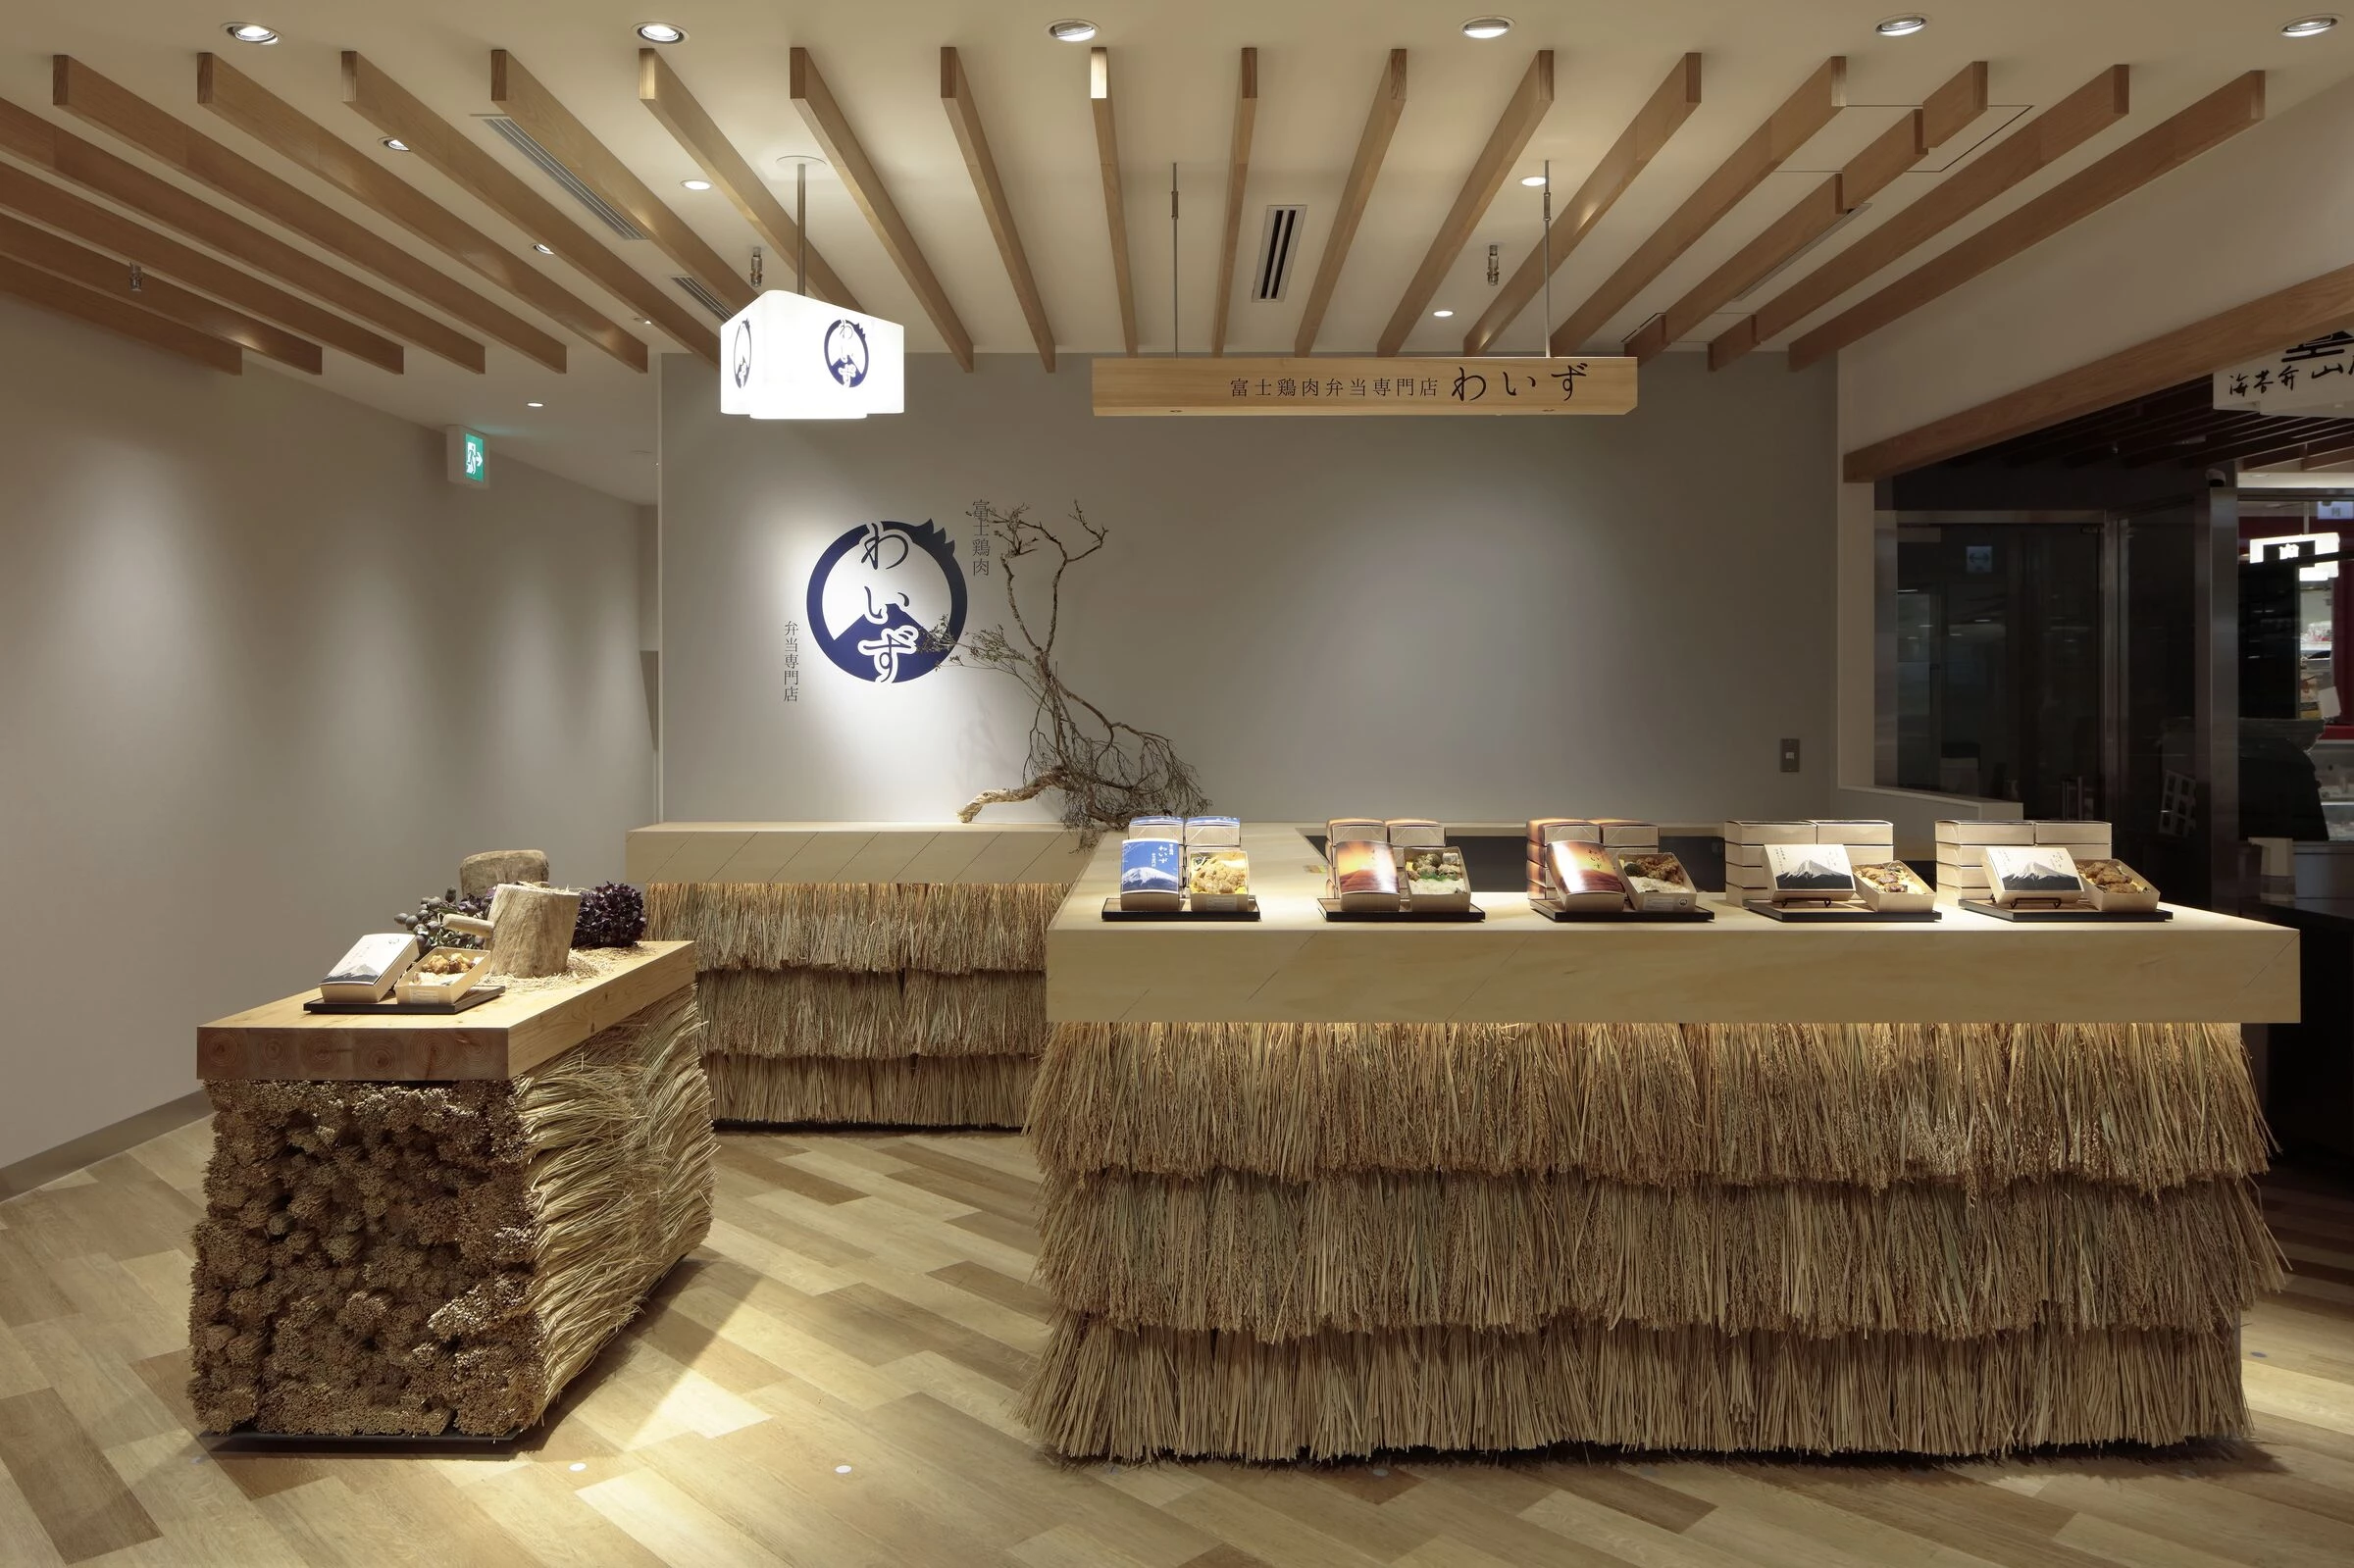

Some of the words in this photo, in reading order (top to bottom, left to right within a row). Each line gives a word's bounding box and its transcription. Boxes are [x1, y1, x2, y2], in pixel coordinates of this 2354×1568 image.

[1230, 377, 1439, 398] 富士鶏肉弁当専門店
[1451, 362, 1589, 403] わいず
[972, 498, 991, 577] 富士鶏肉
[857, 522, 920, 683] わいず
[783, 621, 799, 702] 弁当専門店
